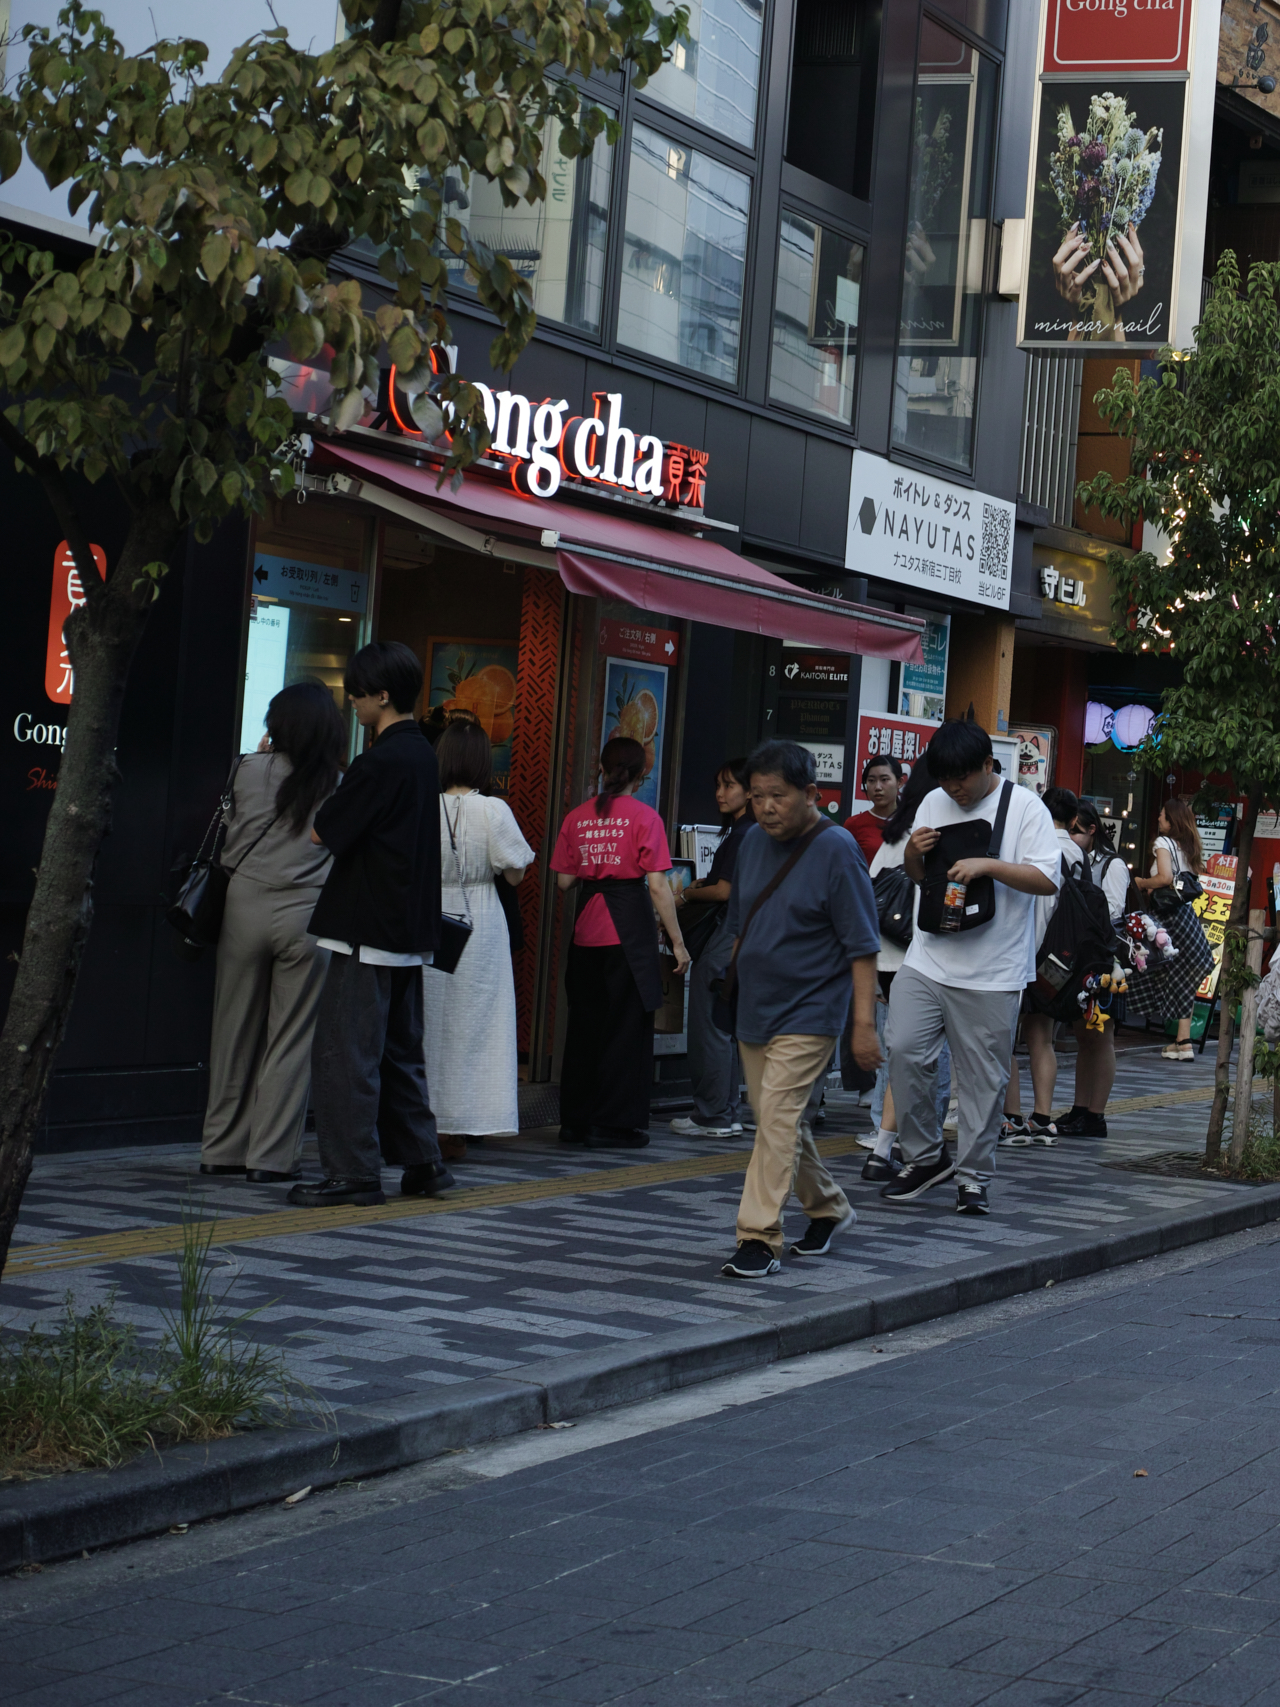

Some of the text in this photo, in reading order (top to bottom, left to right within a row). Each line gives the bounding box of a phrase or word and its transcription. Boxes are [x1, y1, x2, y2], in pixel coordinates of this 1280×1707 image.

[1034, 302, 1163, 335] minear nail
[563, 392, 665, 496] cha
[893, 477, 971, 522] ボイトレ & ダンス
[883, 508, 976, 562] NAYUTAS
[893, 550, 962, 585] ナユタス新宿三丁目校
[977, 580, 1007, 602] 当ビル6F
[1040, 565, 1087, 607] 守ビル
[769, 665, 776, 677] 8
[800, 673, 849, 682] KAITORI ELITE
[766, 709, 773, 721] 7
[589, 842, 618, 854] GREAT
[590, 853, 622, 866] VALUES
[1091, 1012, 1100, 1026] 2
